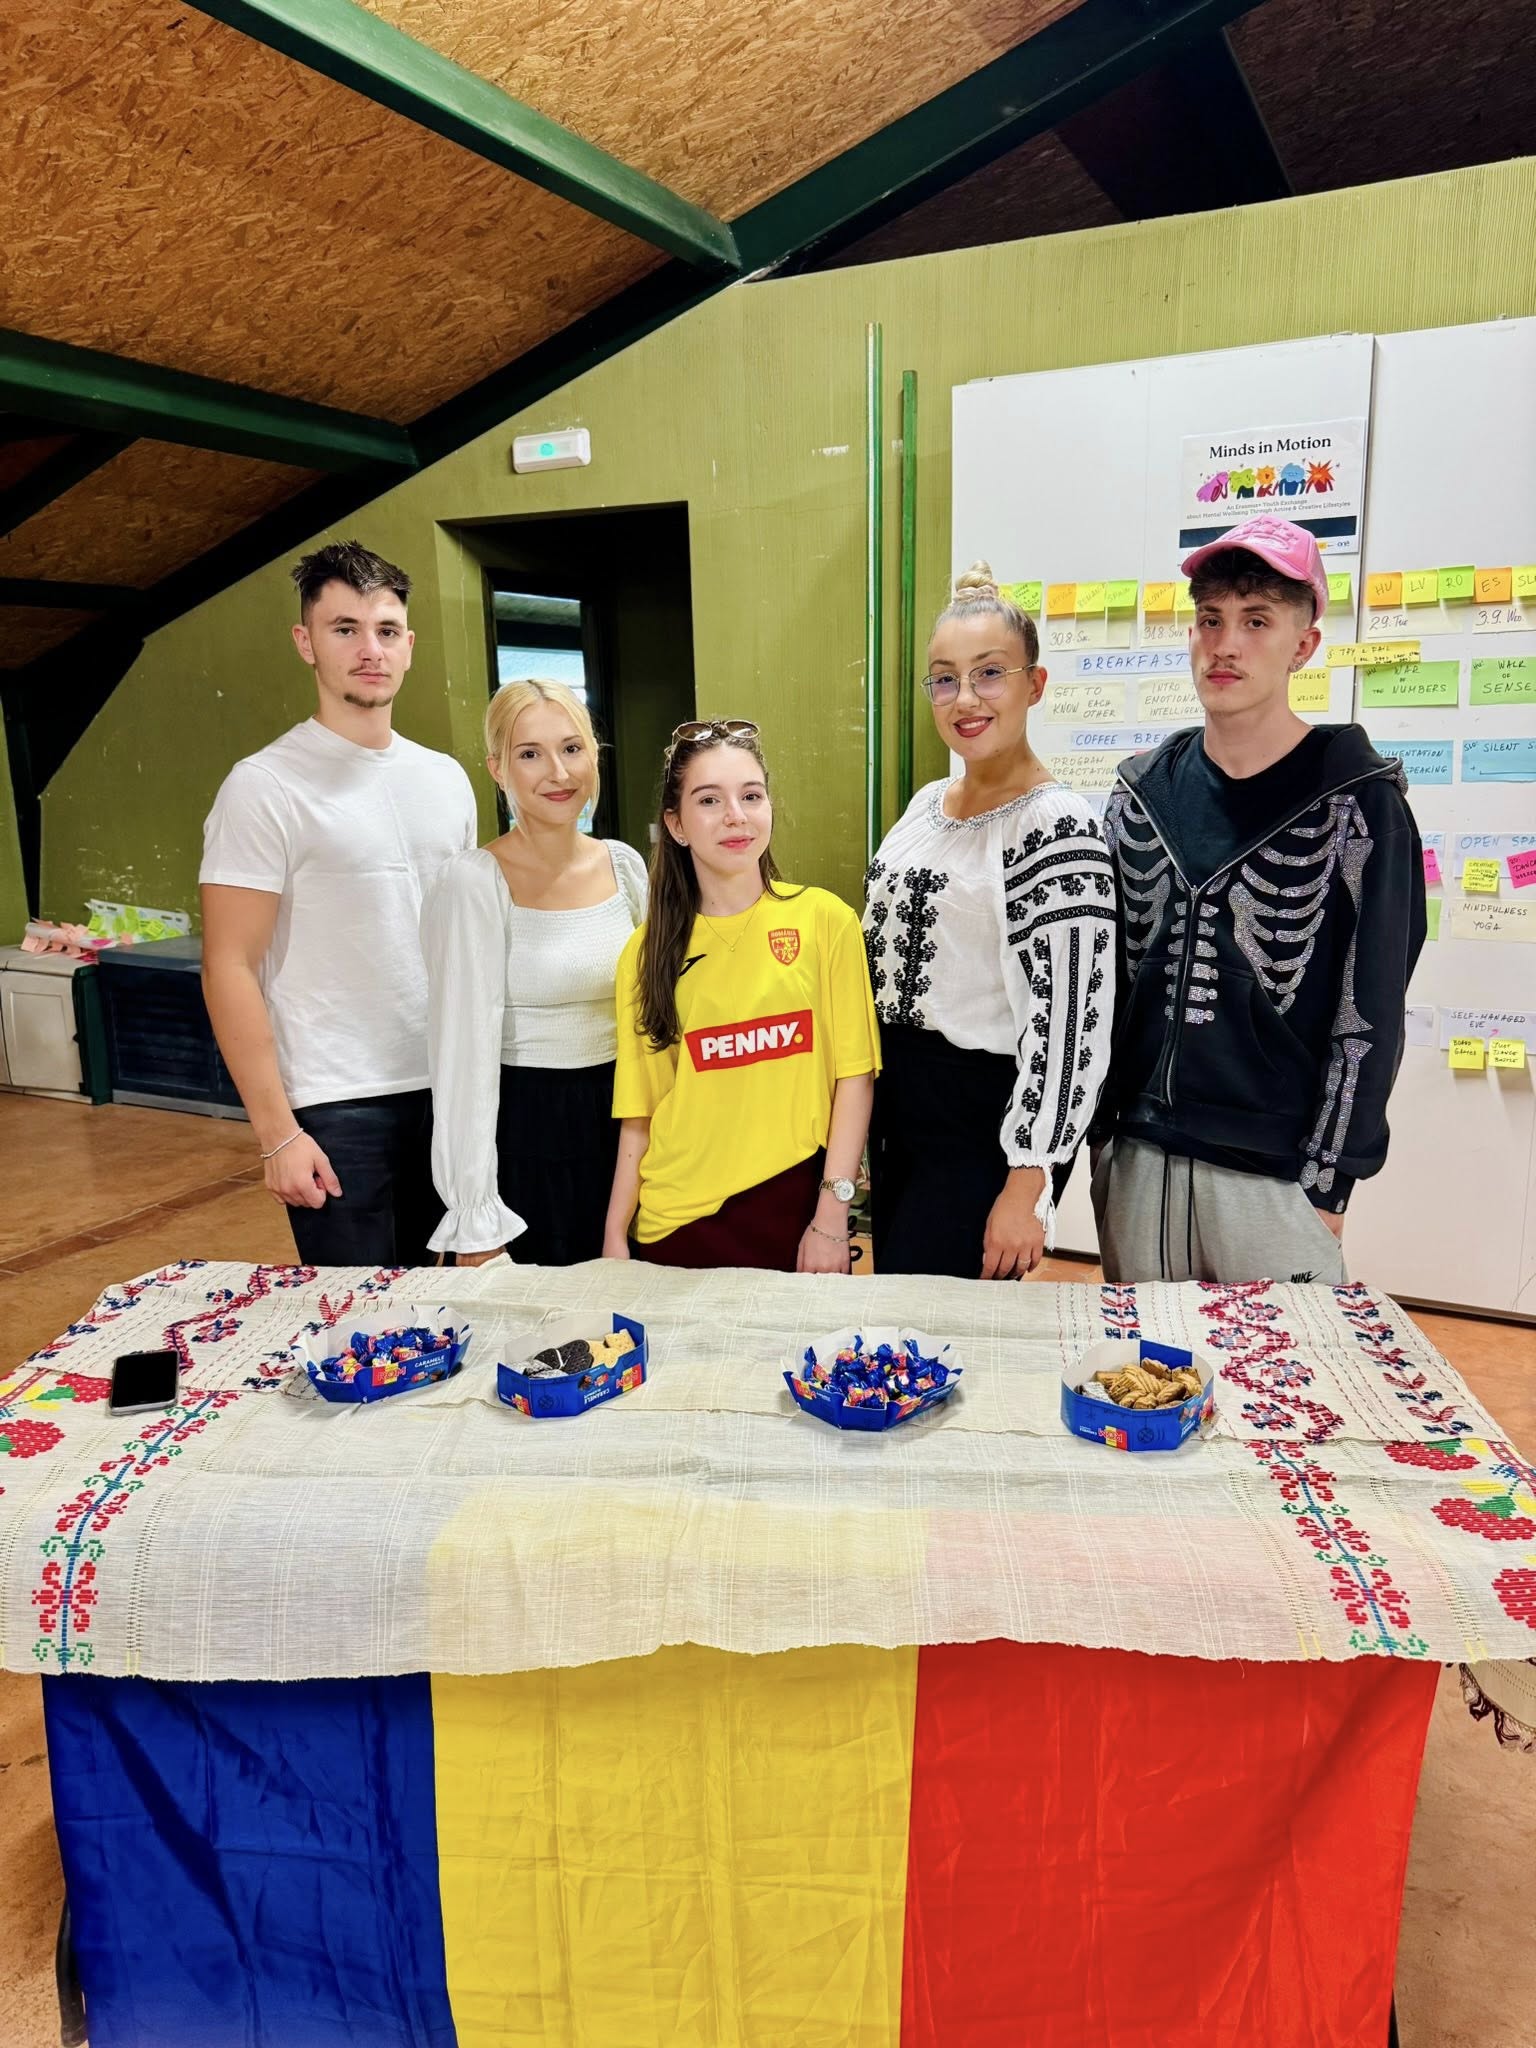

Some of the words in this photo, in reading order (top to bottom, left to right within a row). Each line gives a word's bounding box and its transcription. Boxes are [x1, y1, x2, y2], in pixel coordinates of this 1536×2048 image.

[1209, 443, 1255, 458] Minds
[1258, 440, 1272, 454] in
[1277, 437, 1331, 452] Motion
[1281, 499, 1307, 507] Exchange
[1202, 511, 1221, 519] Mental
[1223, 509, 1248, 518] Wellbeing
[1250, 506, 1272, 514] Through
[1323, 501, 1350, 509] Lifestyles
[1411, 577, 1426, 592] LV
[1482, 577, 1501, 592] ES
[1517, 575, 1536, 588] SL
[1375, 582, 1392, 595] HU
[1083, 653, 1189, 670] BREAKFAST
[1498, 660, 1526, 669] WALK
[1293, 672, 1326, 680] MORNING
[1054, 687, 1077, 698] GET
[1085, 686, 1102, 696] TO
[1152, 682, 1180, 693] INTRO
[1392, 684, 1447, 694] NUMBERS
[1145, 694, 1199, 705] EMOTIONA
[1053, 702, 1079, 715] KNOW
[1088, 699, 1111, 708] EACH
[1150, 706, 1204, 716] INTELLIGENC
[1083, 709, 1116, 719] OTHER
[1076, 734, 1118, 746] COFFEE
[1483, 742, 1520, 752] SILENT
[1460, 835, 1500, 849] OPEN
[1463, 903, 1528, 916] MINDFULNESS
[1473, 921, 1502, 930] YOGA
[1451, 1011, 1526, 1023] SELF-MANAGED
[1291, 1271, 1313, 1283] NIKE
[415, 1355, 445, 1368] CARAMELE
[378, 1366, 407, 1379] ROM
